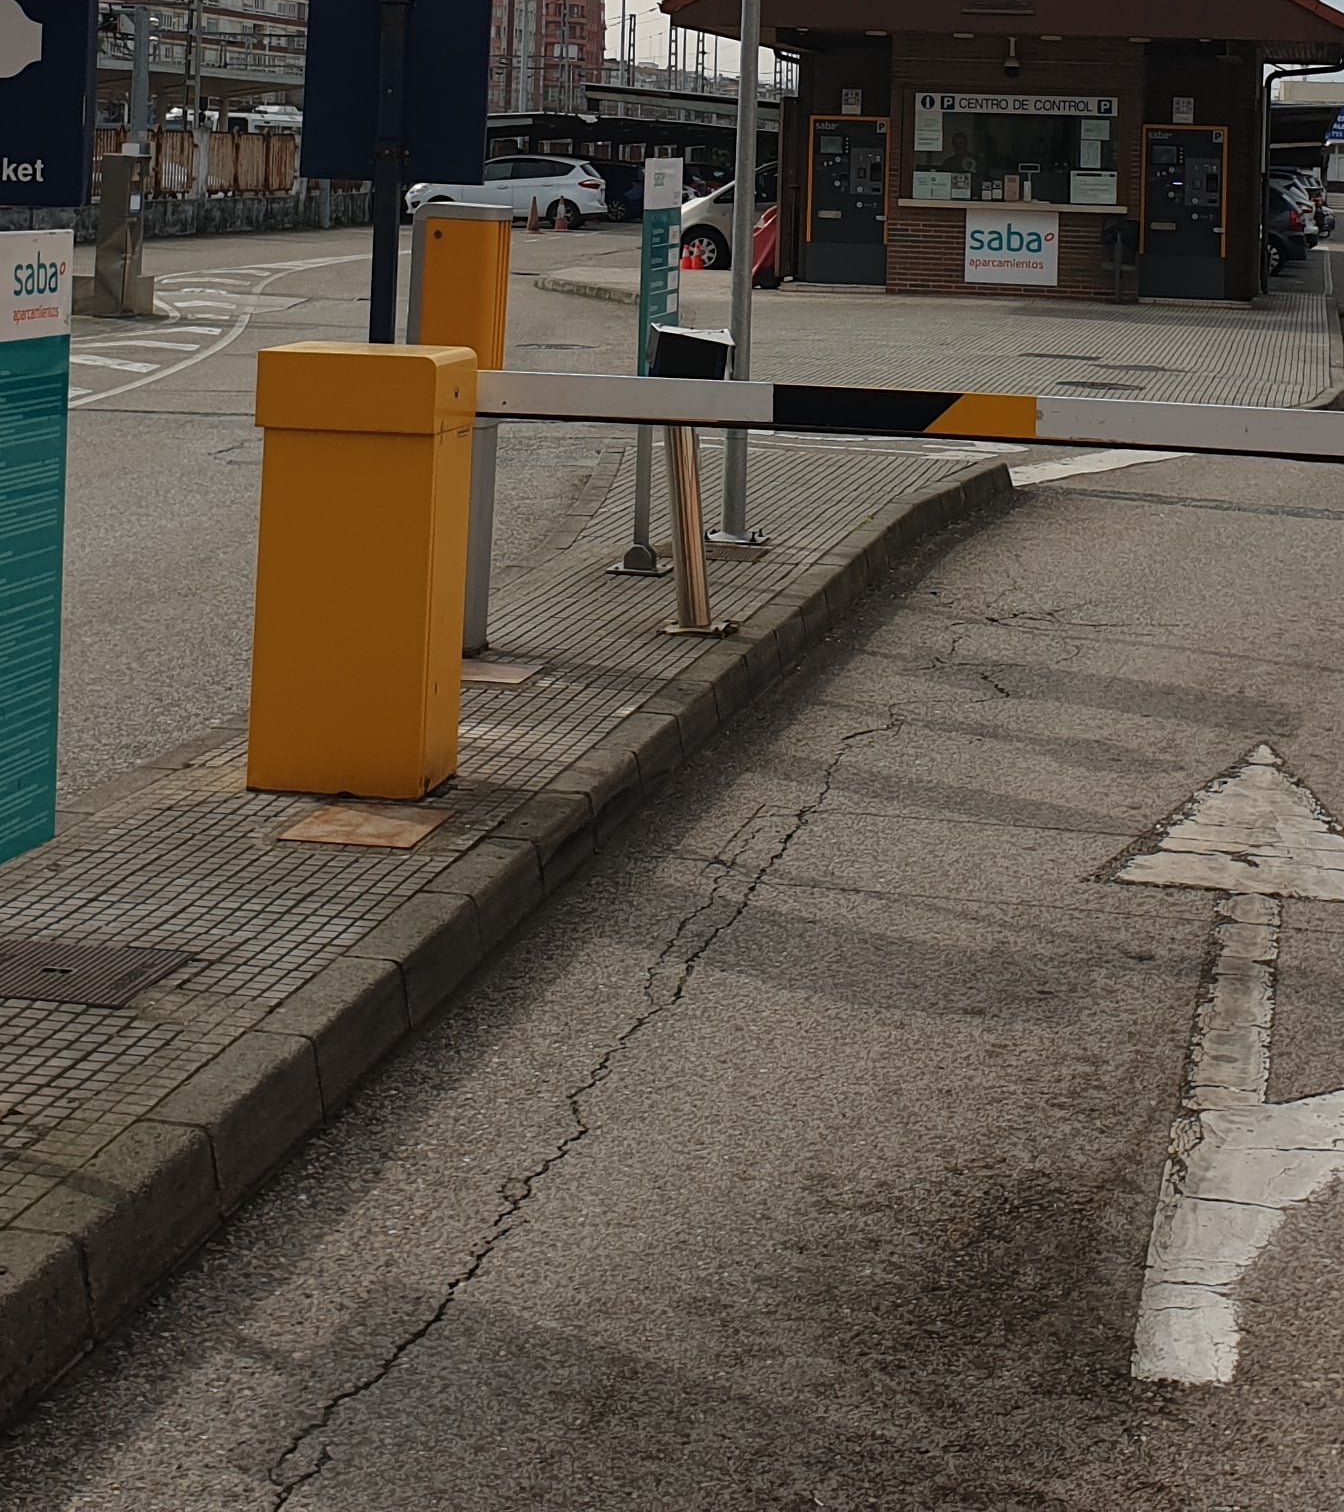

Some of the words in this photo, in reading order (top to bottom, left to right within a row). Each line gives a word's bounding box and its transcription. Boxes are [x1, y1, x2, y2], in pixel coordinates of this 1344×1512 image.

[958, 97, 1009, 110] CENTRO
[1012, 98, 1029, 111] DE
[1033, 99, 1093, 112] CONTROL
[969, 223, 1043, 253] saba
[13, 251, 60, 297] saba
[968, 258, 1044, 270] aparcamientos
